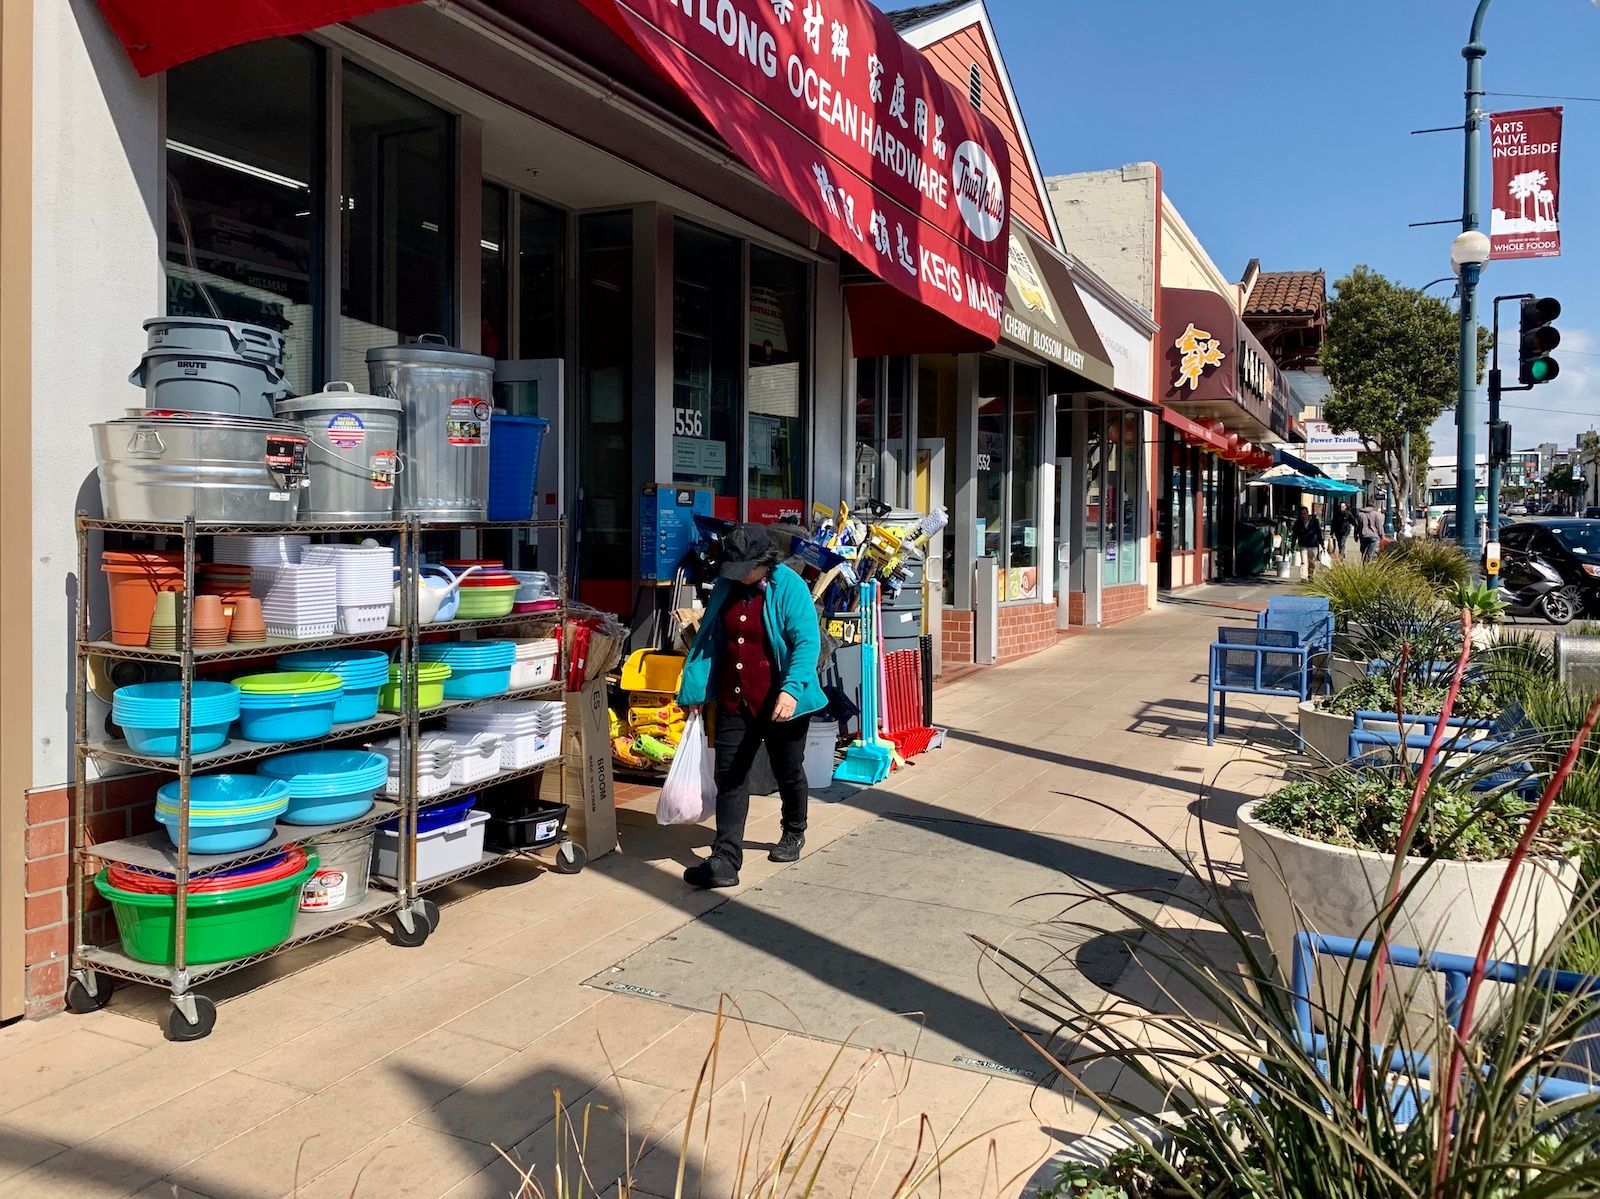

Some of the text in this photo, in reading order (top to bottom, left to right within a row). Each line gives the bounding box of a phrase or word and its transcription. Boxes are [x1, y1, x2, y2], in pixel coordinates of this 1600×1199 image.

[699, 0, 948, 210] LONG OCEAN HARDWARE
[1493, 121, 1524, 134] ARTS
[1493, 133, 1527, 146] ALIVE
[1493, 142, 1558, 158] INGLESIDE
[1494, 241, 1556, 251] WHOLE FOODS
[919, 244, 963, 303] KEYS
[965, 273, 1003, 324] MADE
[1004, 313, 1031, 344] CHERRY
[1033, 329, 1062, 362] BLOSSOM
[1063, 346, 1085, 370] BAKERY
[177, 361, 207, 369] BRUTE
[1334, 436, 1362, 444] Trading
[597, 757, 606, 801] BROOM
